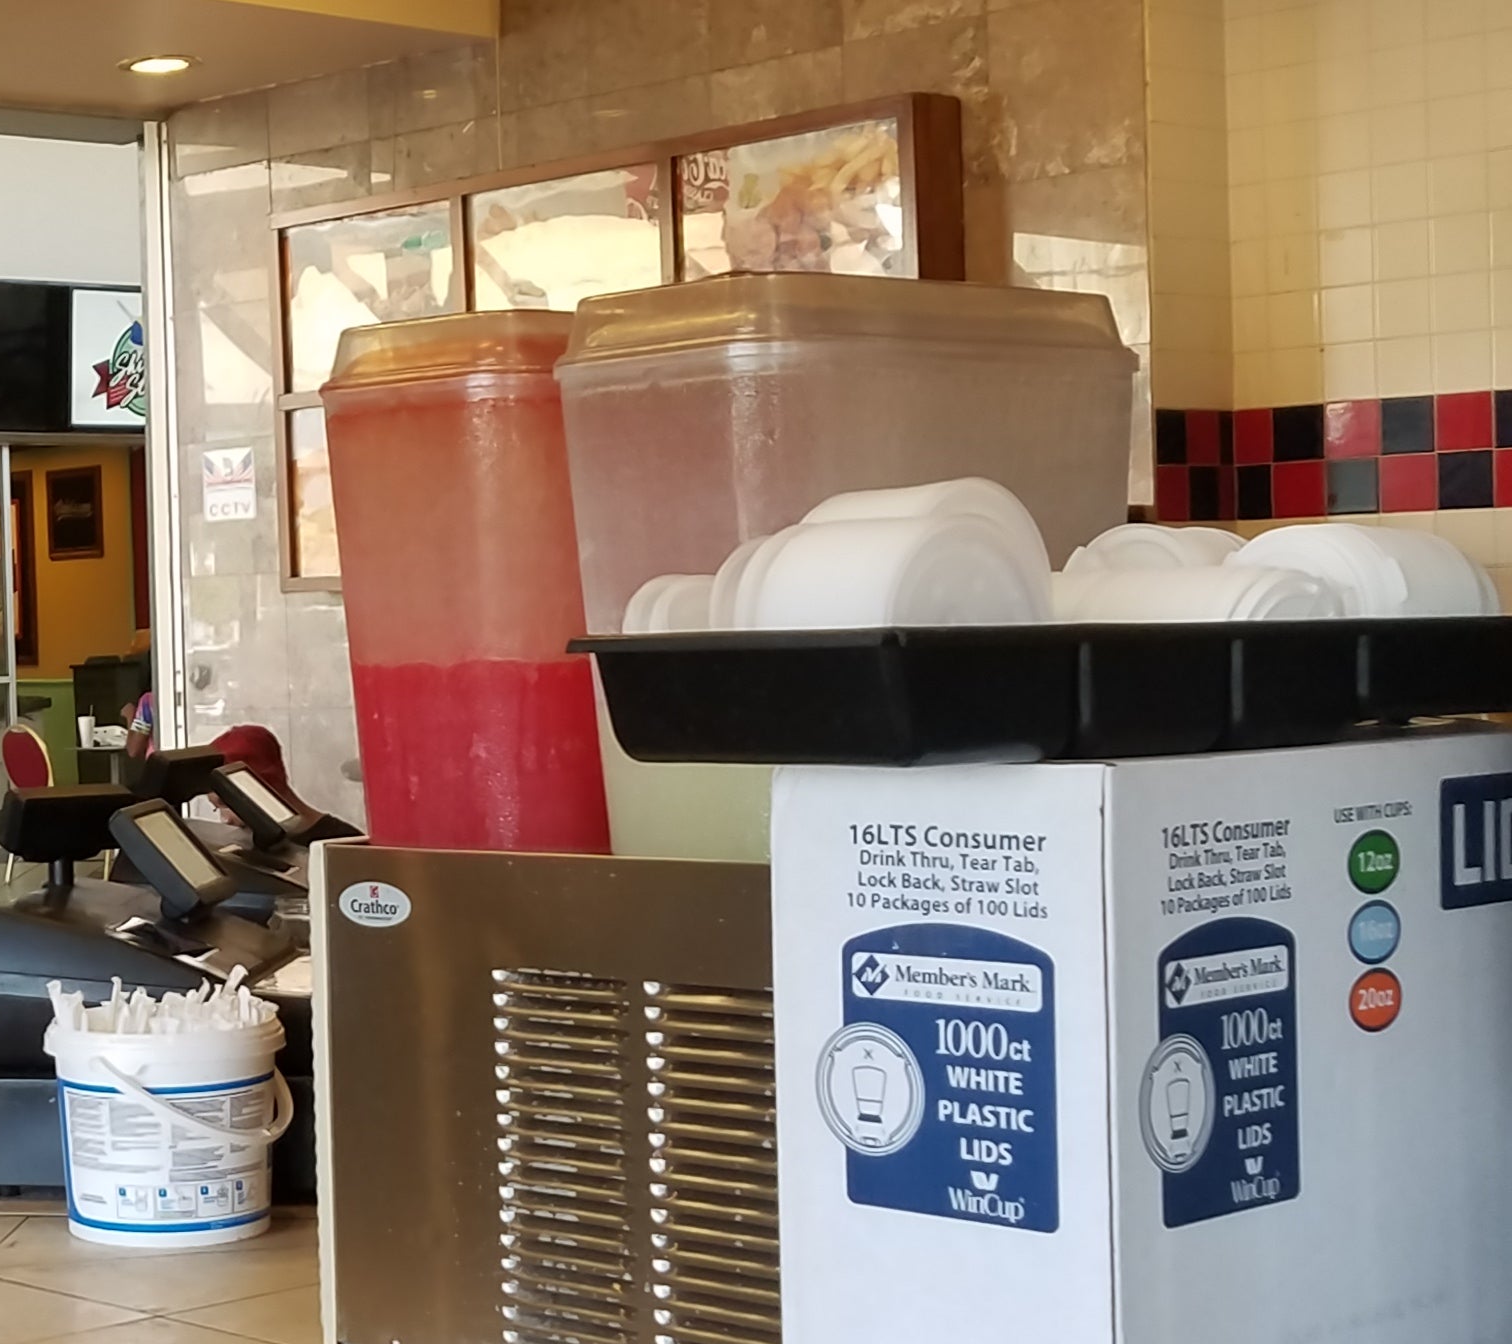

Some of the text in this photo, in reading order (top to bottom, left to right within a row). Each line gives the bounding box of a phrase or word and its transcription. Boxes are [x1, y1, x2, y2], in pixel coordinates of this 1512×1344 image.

[209, 501, 251, 517] CCTV
[1334, 807, 1355, 824] USE
[849, 824, 1047, 852] 16LTS Consumer
[1162, 819, 1291, 849] 16LTS Consumer
[860, 849, 1040, 875] Drink Thru, Tear Tab,
[1169, 850, 1202, 869] Drink
[1235, 845, 1261, 861] Tear
[1357, 850, 1394, 872] 12oz
[858, 871, 1040, 896] Lock Back, Straw Slot
[1168, 872, 1195, 892] Lock
[1230, 868, 1262, 885] Straw
[1264, 863, 1287, 881] Slot
[350, 899, 398, 915] Crathco
[847, 893, 1048, 919] 10 Packages of 100 Lids
[1161, 884, 1291, 915] 10 Packages of 100 Lids
[895, 965, 978, 988] Member's
[982, 971, 1033, 993] Mark
[1194, 962, 1248, 985] Member's
[1250, 955, 1285, 976] Mark
[904, 989, 1022, 1006] FOOD SERVICE
[1358, 988, 1394, 1010] 20oz
[935, 1019, 1032, 1062] 1000ct
[1220, 1007, 1283, 1050] 1000ct
[946, 1064, 1024, 1095] WHITE
[1228, 1052, 1278, 1080] WHITE
[1223, 1085, 1285, 1117] PLASTIC
[938, 1099, 1035, 1133] PLASTIC
[1237, 1122, 1272, 1150] LIDS
[959, 1137, 1013, 1166] LIDS
[1230, 1175, 1281, 1203] WinCup
[947, 1186, 1025, 1223] WinCup
